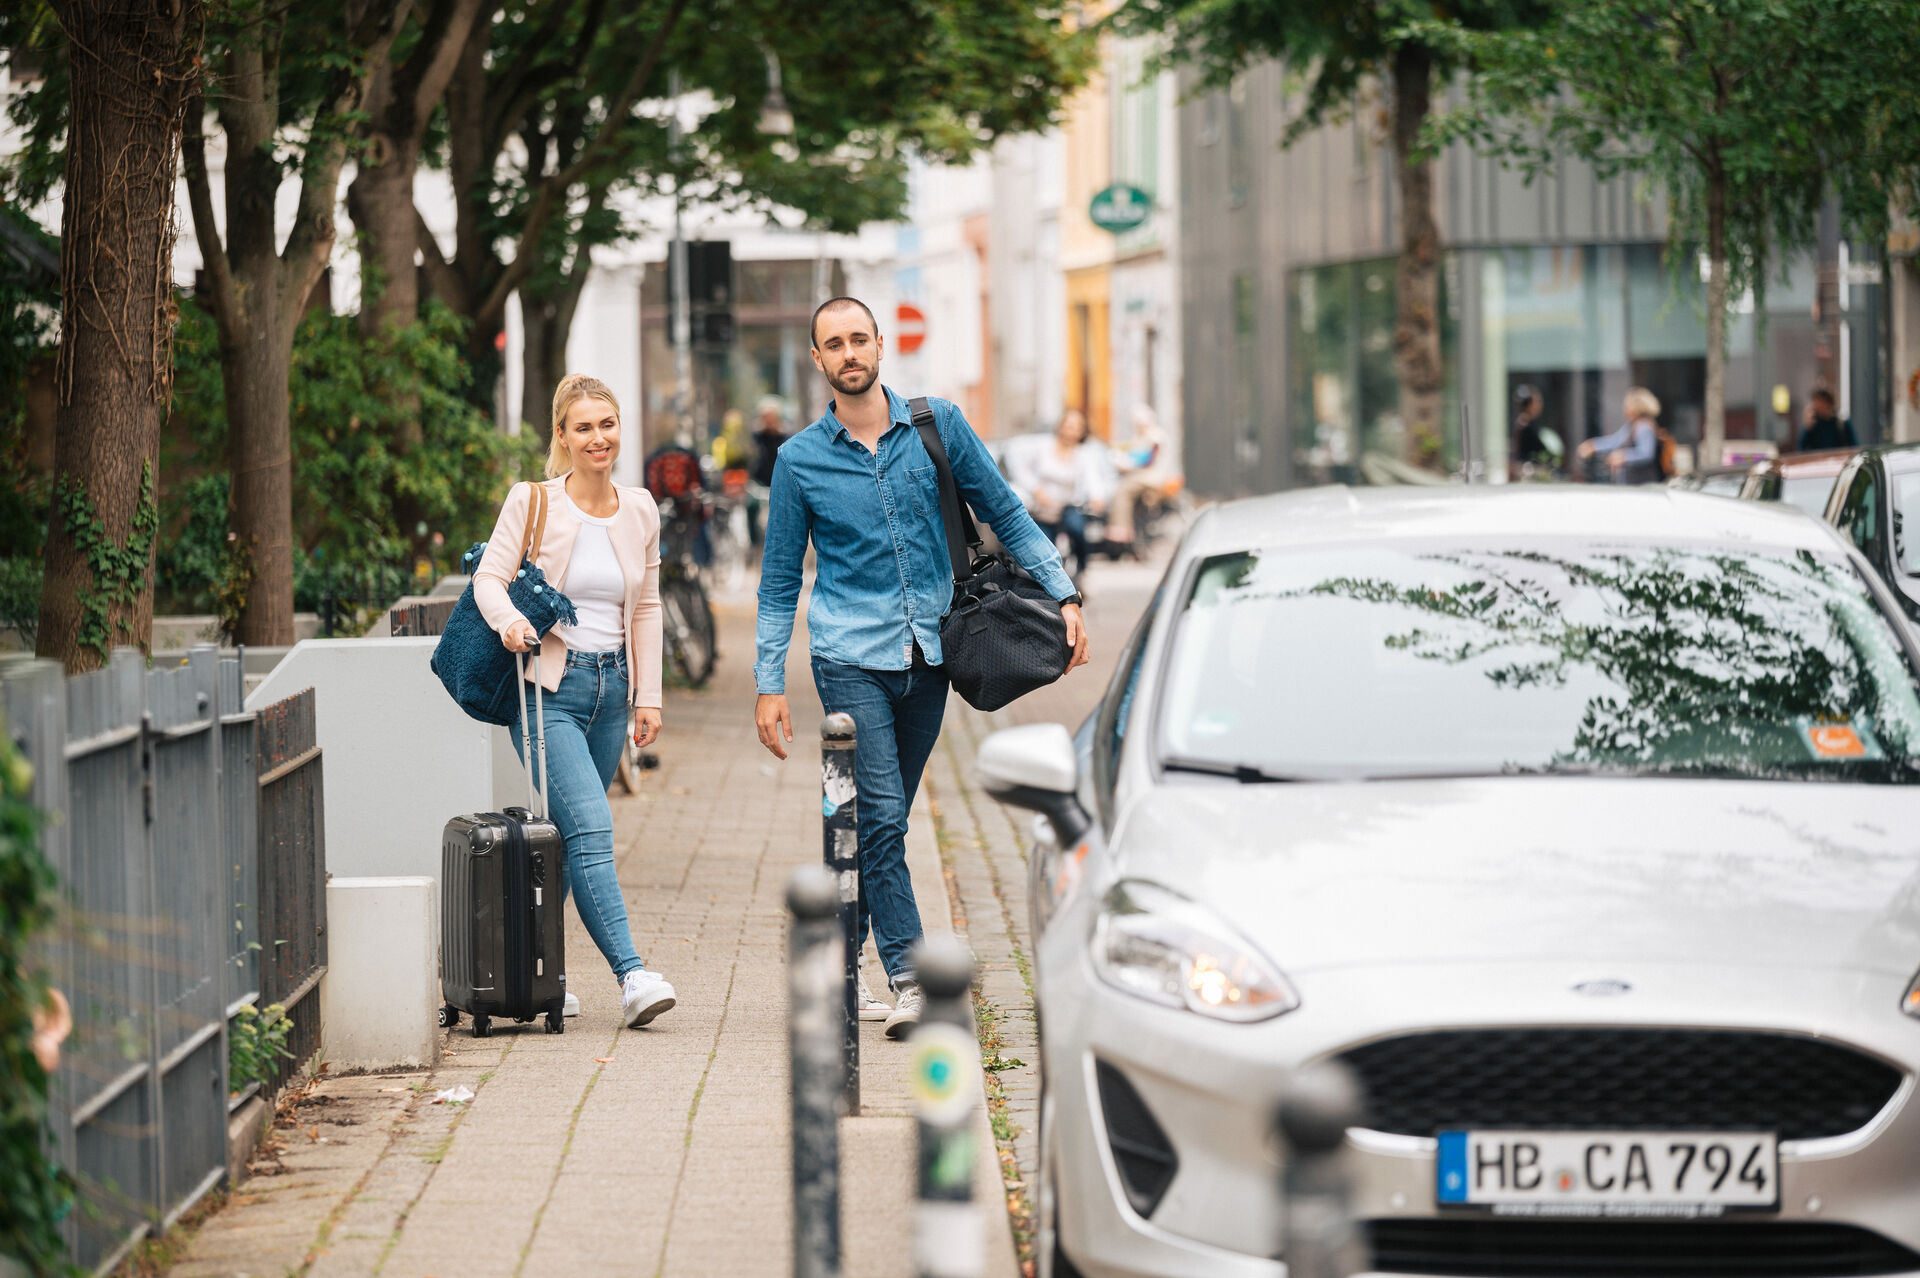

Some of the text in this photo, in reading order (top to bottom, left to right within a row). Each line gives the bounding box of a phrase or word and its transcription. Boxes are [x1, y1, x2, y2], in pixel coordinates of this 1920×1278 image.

[1475, 1143, 1543, 1190] HB
[1584, 1143, 1652, 1191] CA
[1668, 1144, 1767, 1192] 794
